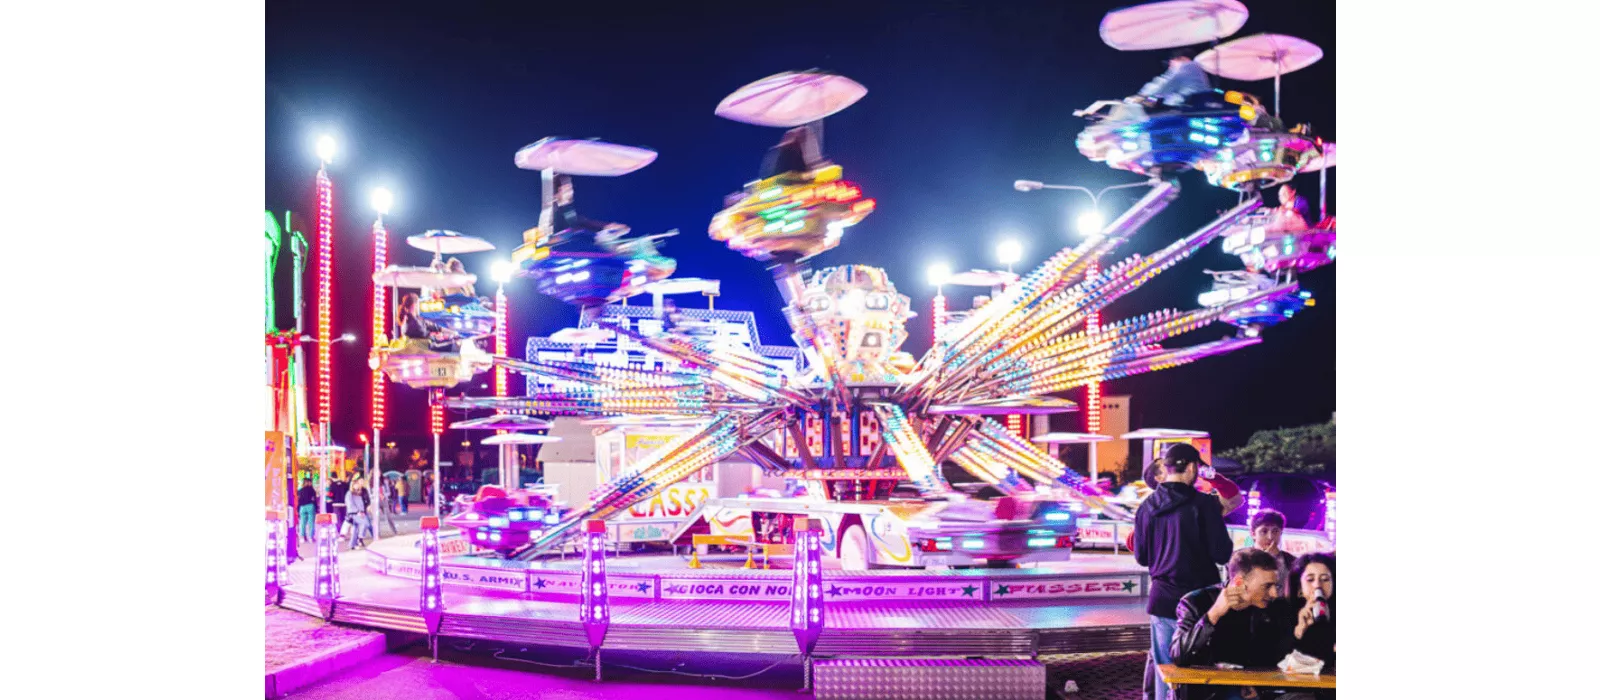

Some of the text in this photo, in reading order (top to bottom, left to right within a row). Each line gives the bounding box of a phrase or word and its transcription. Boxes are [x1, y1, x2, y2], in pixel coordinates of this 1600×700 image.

[678, 584, 724, 595] GIOCA
[729, 585, 760, 596] CON
[843, 586, 960, 597] MOON LIGHT
